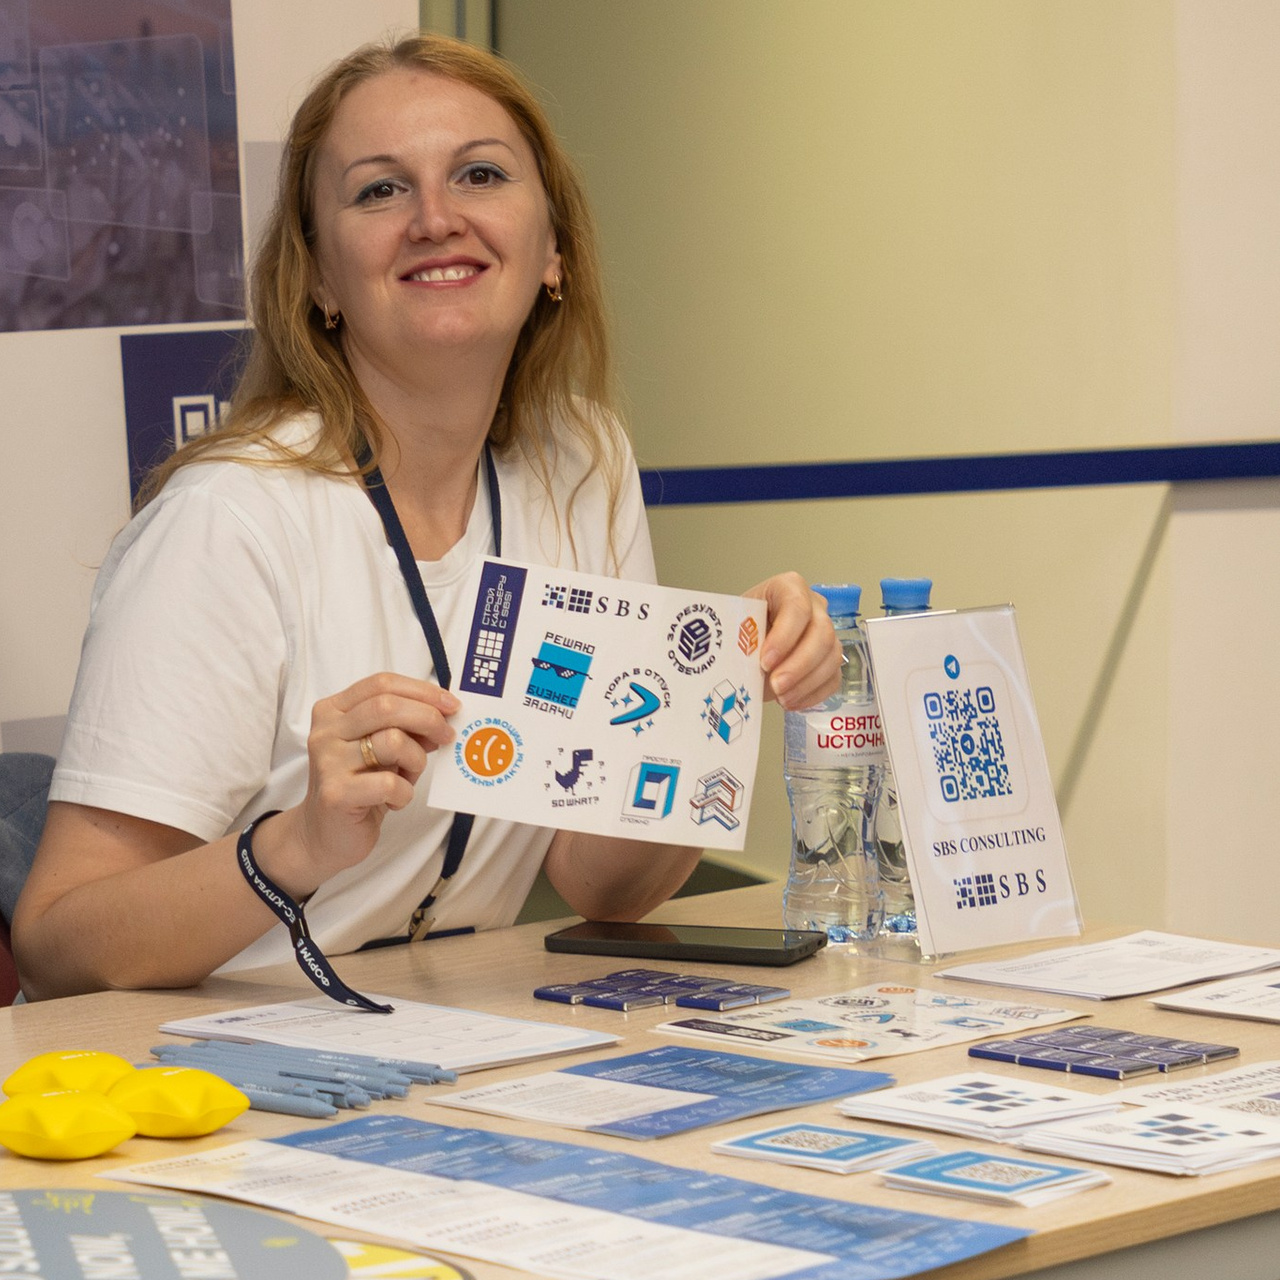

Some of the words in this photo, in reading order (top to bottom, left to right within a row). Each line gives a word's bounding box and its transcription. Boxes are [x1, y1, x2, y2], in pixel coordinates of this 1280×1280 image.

[482, 587, 496, 625] СТРОЙ
[490, 574, 507, 627] КАРЬЕРУ
[596, 596, 650, 620] SBS
[676, 603, 722, 649] РЕЗУЛЬТАТ
[544, 631, 595, 655] РЕШАЮ
[668, 650, 716, 675] ОТВЕЧАЮ
[527, 684, 579, 708] БИЗНЕС
[604, 671, 630, 700] ПОРА
[644, 668, 671, 709] ОТПУСК
[523, 697, 574, 720] ЗАДАЧИ
[462, 719, 482, 737] ЭТО
[552, 799, 565, 808] SO
[566, 796, 599, 807] WHAT?
[933, 839, 958, 858] SBS
[960, 826, 1046, 853] CONSULTING
[241, 848, 254, 876] ВШЭ
[999, 869, 1047, 899] SBS
[299, 946, 331, 988] ФОРУМ
